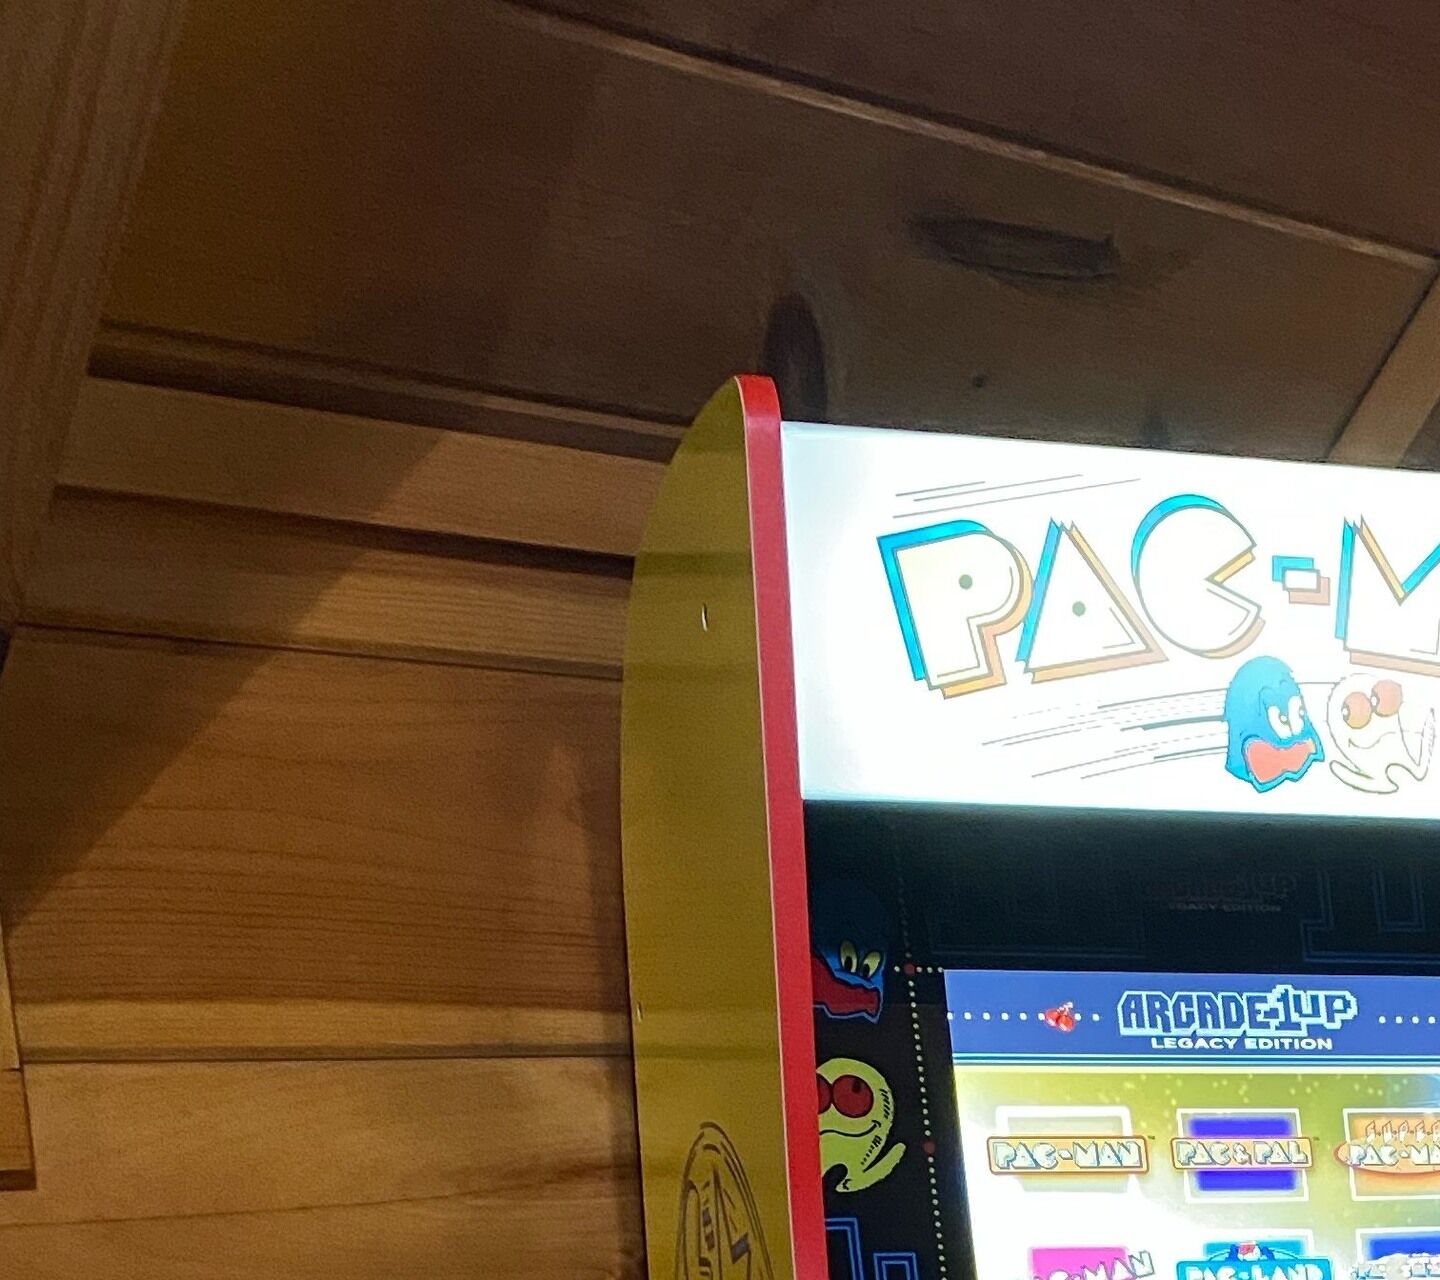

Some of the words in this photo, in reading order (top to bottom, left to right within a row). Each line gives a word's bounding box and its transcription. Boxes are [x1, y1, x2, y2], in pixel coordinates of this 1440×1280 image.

[1151, 1036, 1237, 1050] LEGACY
[1245, 1036, 1333, 1050] EDITION
[991, 1141, 1143, 1169] PAC-MAN
